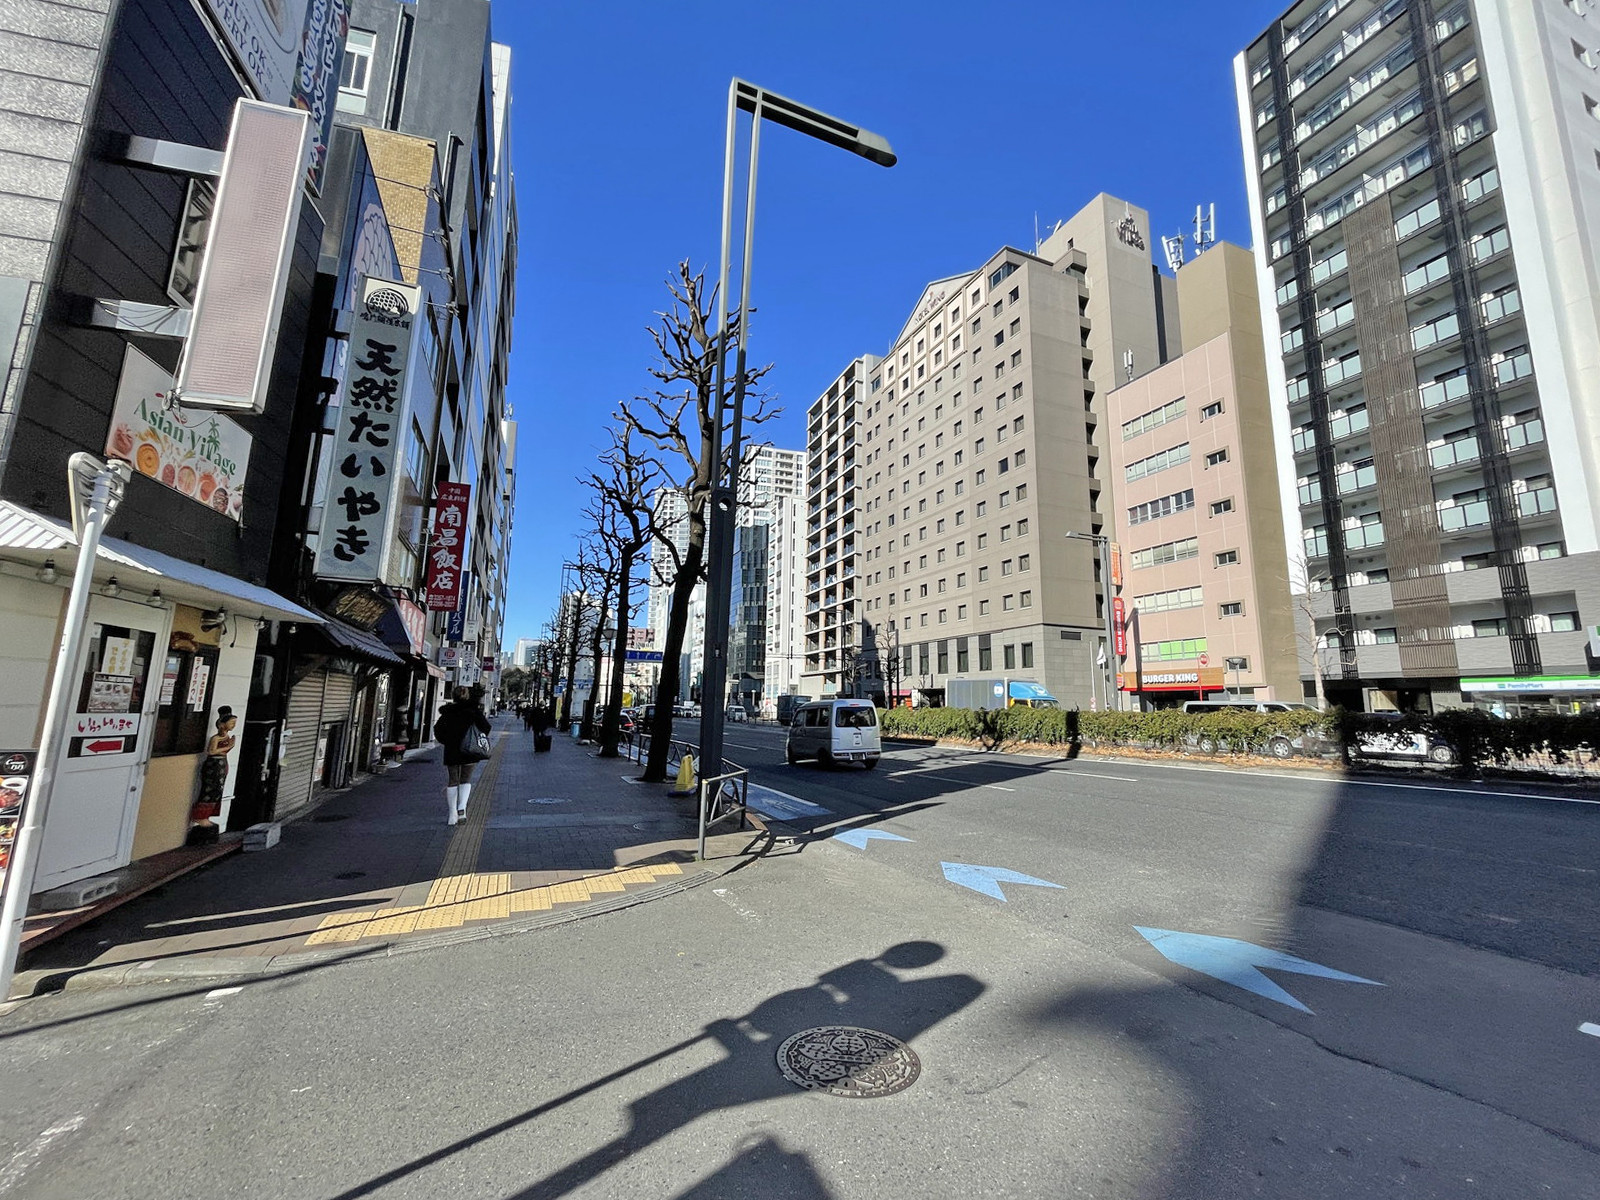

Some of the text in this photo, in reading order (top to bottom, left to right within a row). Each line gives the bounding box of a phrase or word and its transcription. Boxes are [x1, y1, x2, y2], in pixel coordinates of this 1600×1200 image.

[248, 52, 264, 85] OK
[251, 36, 266, 69] OK
[134, 398, 237, 476] Asian Village
[334, 338, 401, 562] 天然たいやき
[431, 504, 462, 590] 南昌飯店
[1142, 672, 1198, 684] BURGER KING
